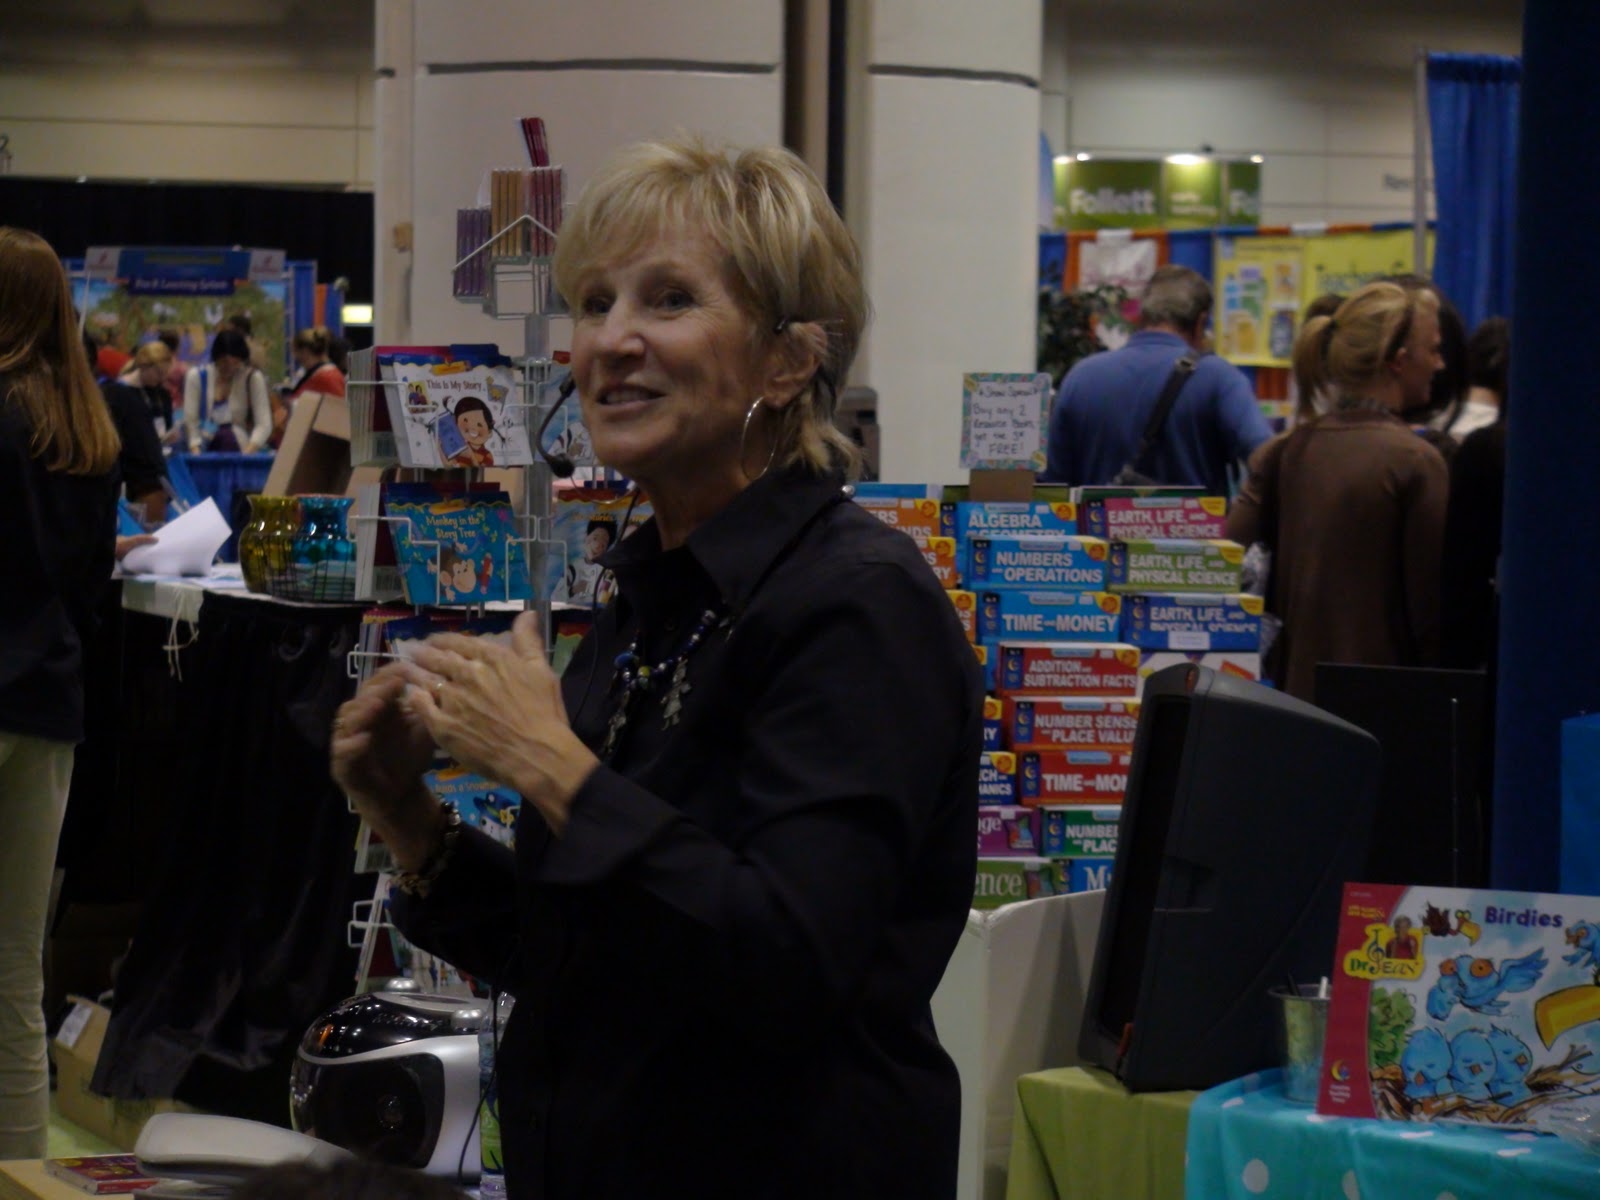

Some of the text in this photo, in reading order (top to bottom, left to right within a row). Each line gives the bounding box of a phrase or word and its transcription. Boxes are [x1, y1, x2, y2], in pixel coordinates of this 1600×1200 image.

[426, 380, 483, 392] This Is My Story
[973, 403, 1027, 420] Buy any 2
[425, 514, 481, 529] Monkey in the
[968, 514, 1043, 528] ALGEBRA
[1108, 510, 1154, 524] EARTH,
[435, 527, 477, 541] Story Tree
[1108, 524, 1222, 538] PHYSICAL SCIENCE
[996, 551, 1073, 567] NUMBERS
[1129, 555, 1174, 570] EARTH,
[1004, 567, 1104, 583] OPERATIONS
[1128, 569, 1238, 586] PHYSICAL SCIENCE
[1151, 607, 1195, 622] EARTH,
[1001, 613, 1045, 632] TIME
[1055, 613, 1119, 633] MONEY
[1028, 660, 1082, 673] ADDITION
[1023, 673, 1138, 688] SUBTRACTION FACTS
[1034, 714, 1093, 728] NUMBER
[1051, 729, 1136, 744] PLACE VALU
[1041, 774, 1085, 792] TIME
[1082, 839, 1118, 853] PLAC
[1485, 905, 1563, 928] Birdies
